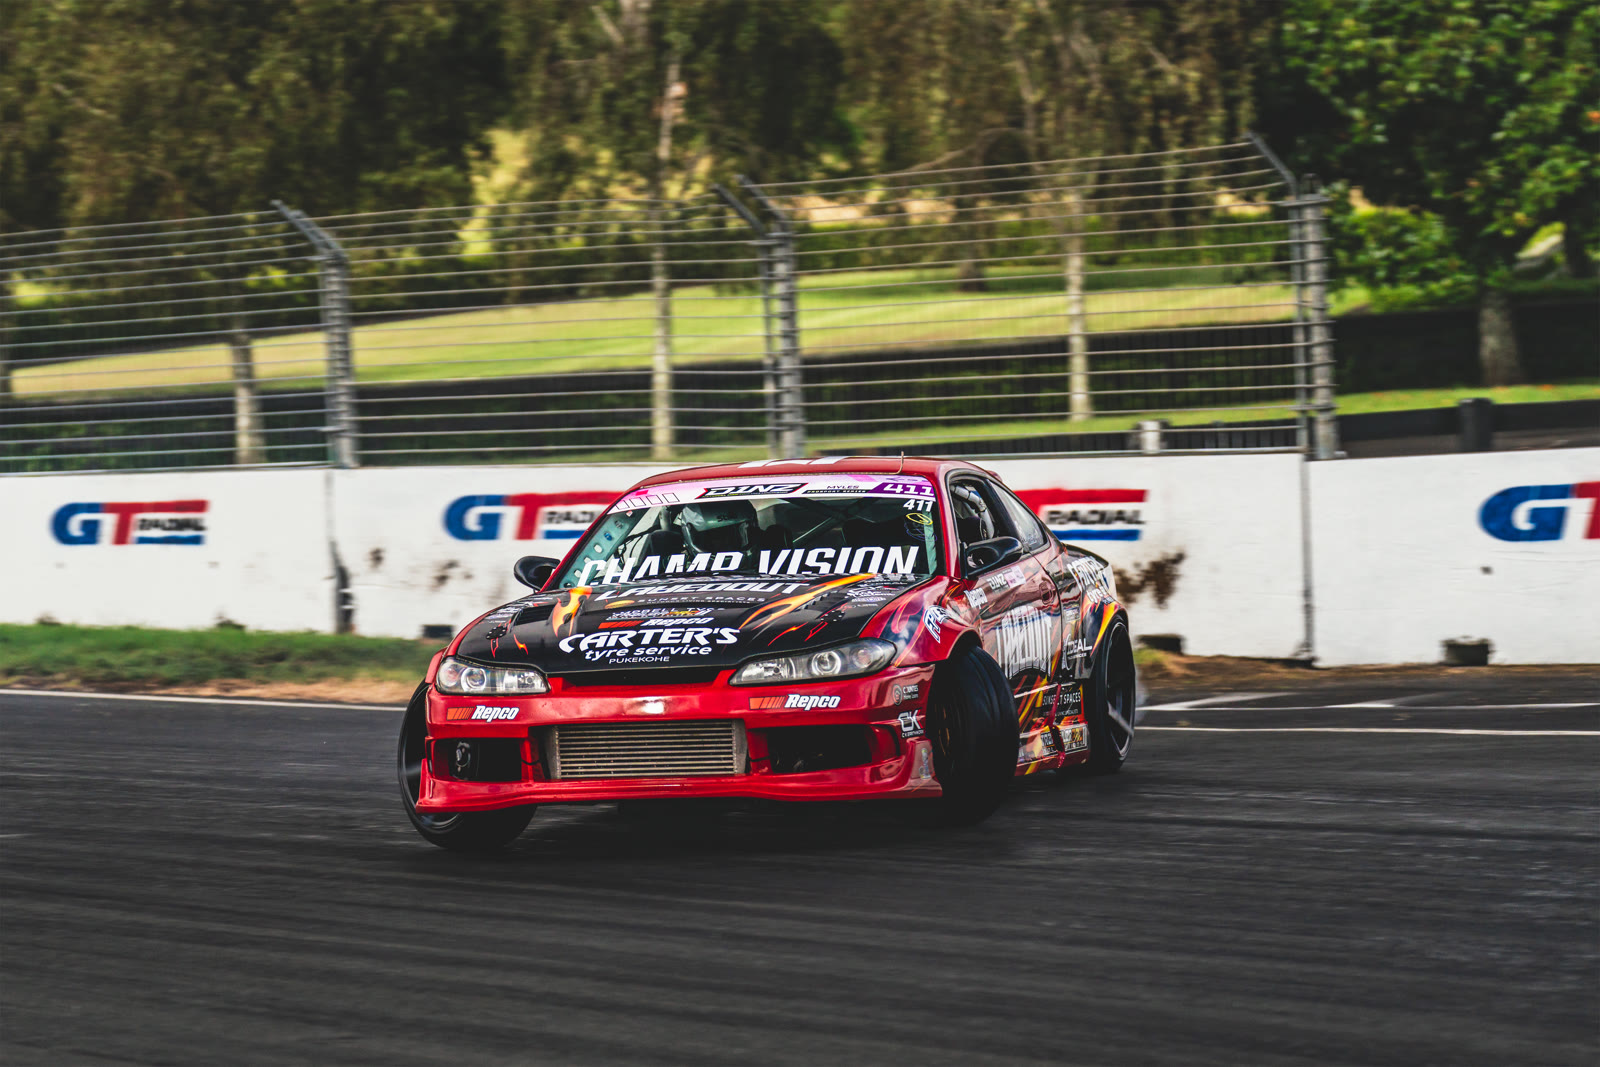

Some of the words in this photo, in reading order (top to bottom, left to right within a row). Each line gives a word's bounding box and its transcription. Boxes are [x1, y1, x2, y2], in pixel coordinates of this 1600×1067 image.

[883, 483, 934, 496] 411
[903, 499, 934, 512] 411
[1045, 510, 1145, 525] RADIAL
[758, 546, 919, 575] VISION
[640, 617, 715, 627] Repco
[558, 627, 741, 654] CARTER'S
[585, 647, 630, 662] tyre
[634, 644, 713, 656] service
[608, 656, 670, 665] PUKEKOHE
[784, 694, 842, 711] Repco
[471, 705, 520, 722] Repco
